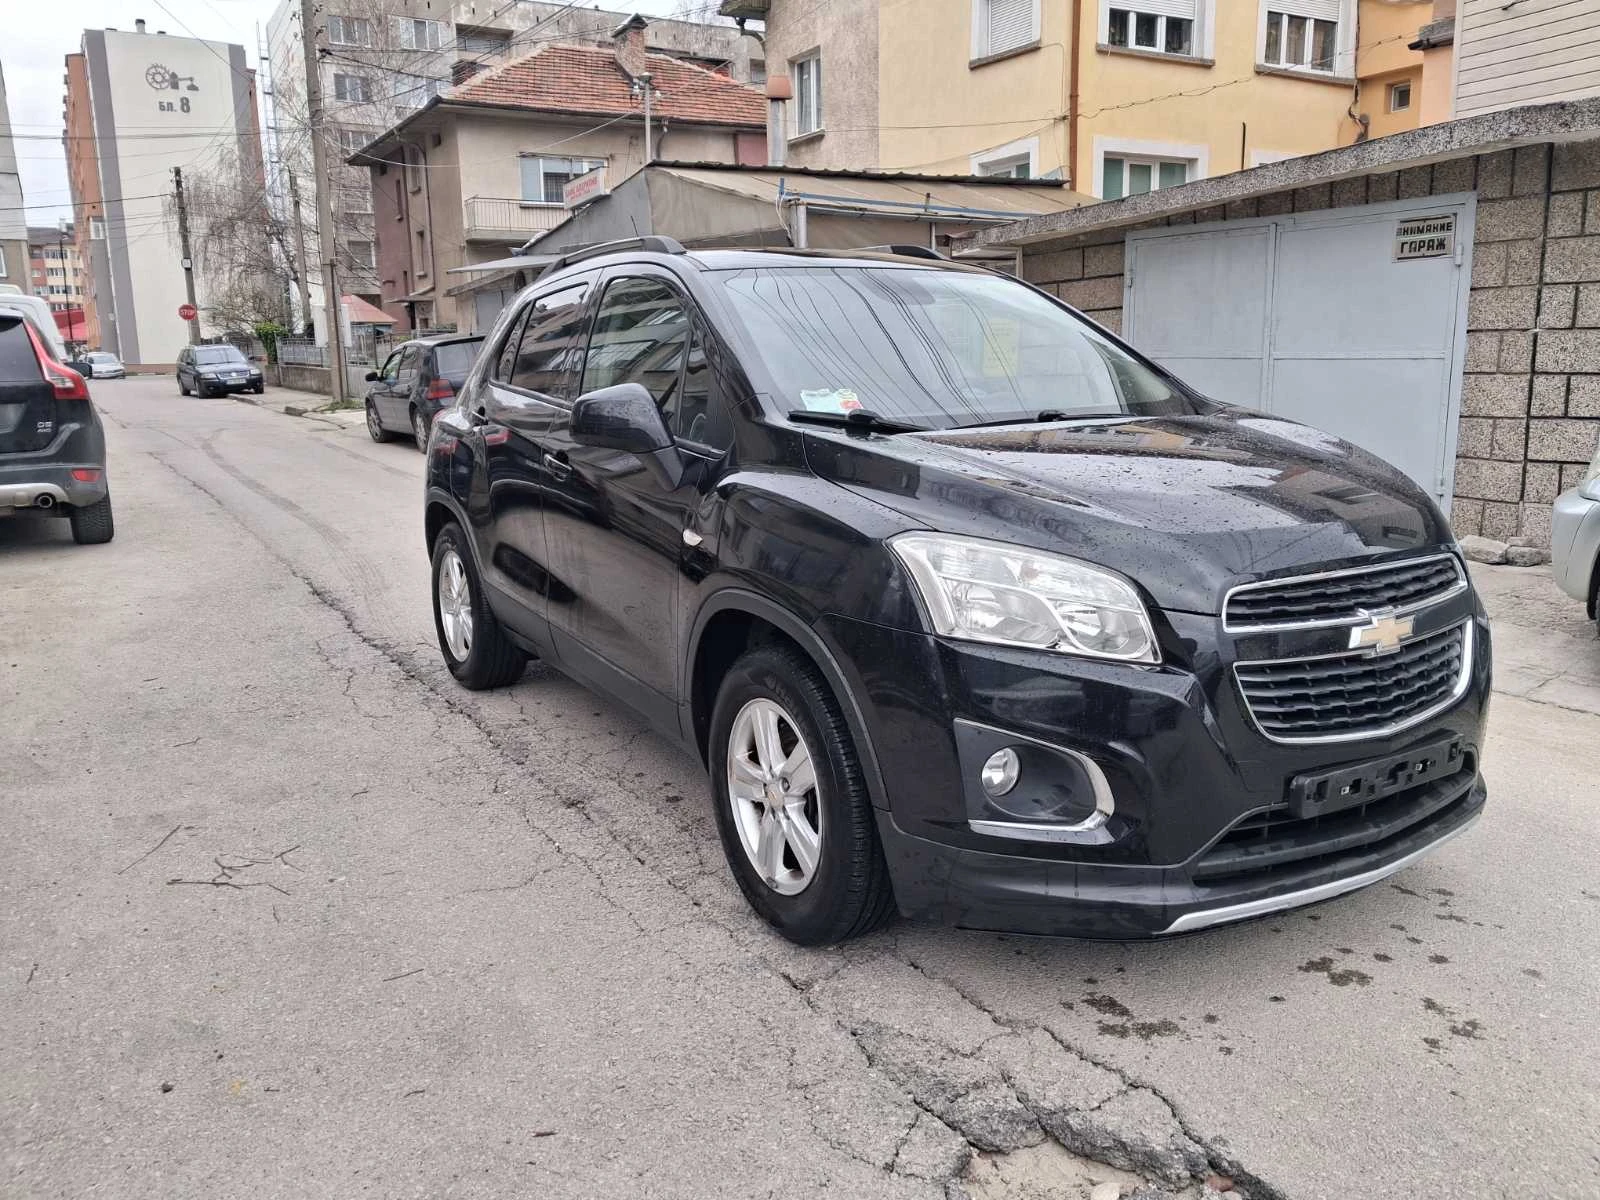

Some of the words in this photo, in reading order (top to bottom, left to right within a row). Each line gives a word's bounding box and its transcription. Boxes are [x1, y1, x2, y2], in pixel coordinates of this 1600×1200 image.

[180, 96, 191, 113] 8
[1400, 237, 1446, 254] ГАРАЖ
[179, 309, 196, 317] STOP
